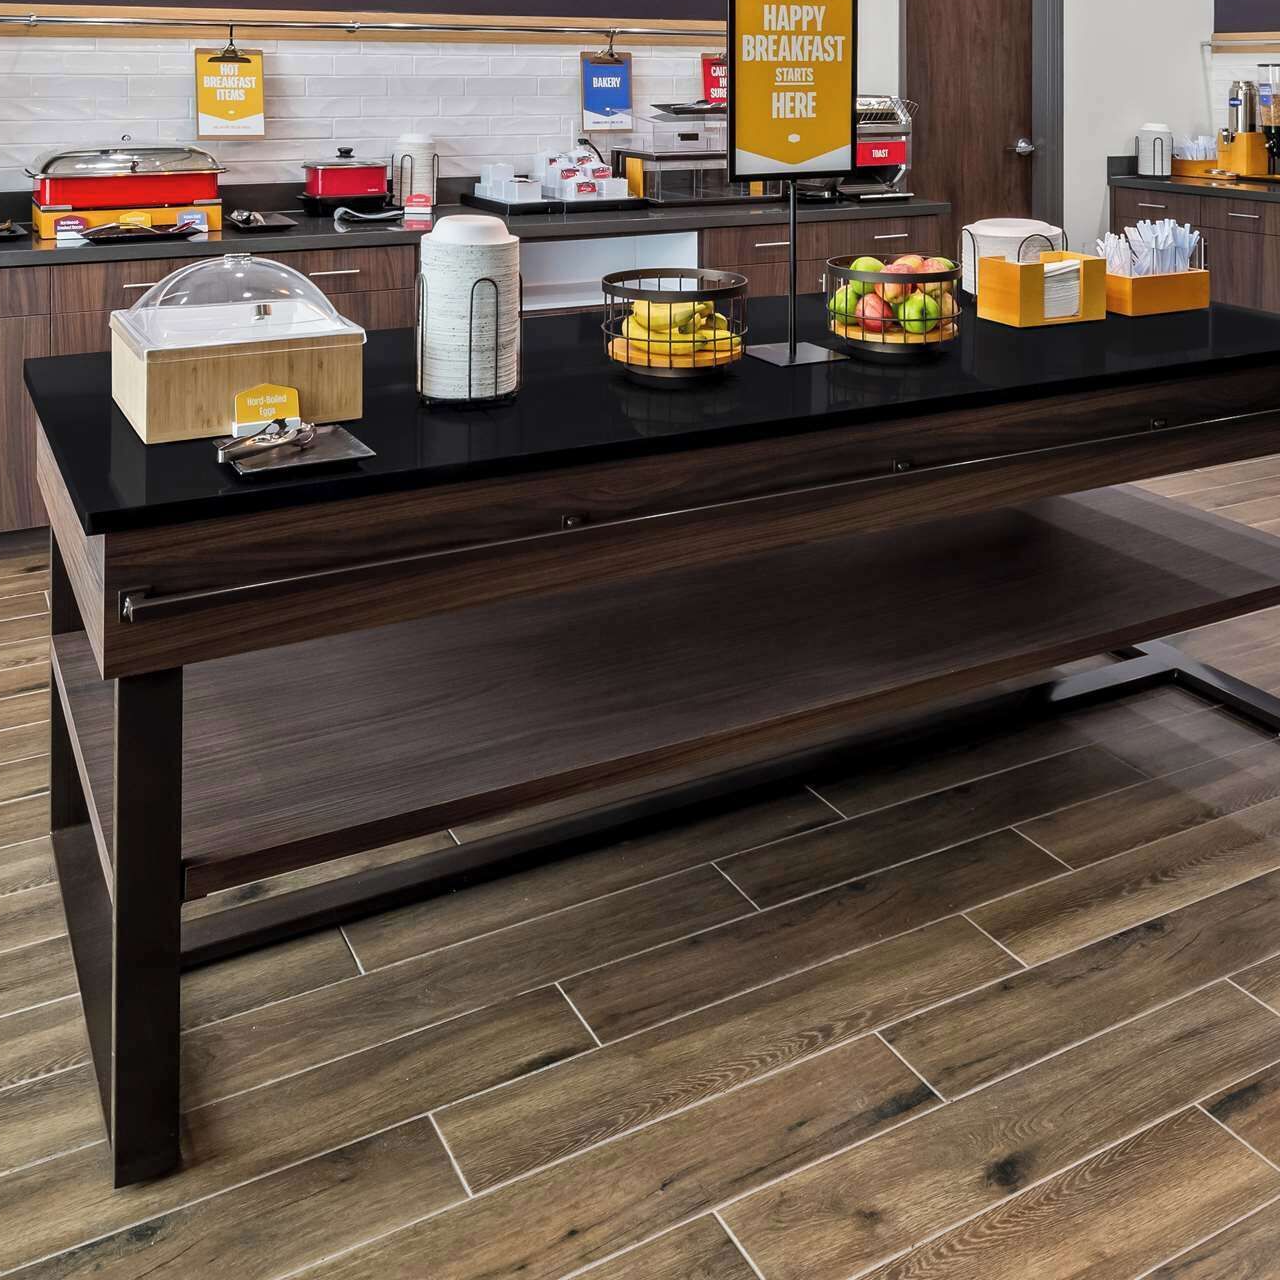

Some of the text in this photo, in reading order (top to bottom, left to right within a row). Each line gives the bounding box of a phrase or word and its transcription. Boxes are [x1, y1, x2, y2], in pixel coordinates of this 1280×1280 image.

[763, 4, 826, 32] HAPPY
[742, 34, 846, 62] BREAKFAST
[220, 64, 239, 76] HOT
[775, 67, 814, 82] STARTS
[203, 75, 257, 89] BREAKFAST
[592, 77, 621, 88] BAKERY
[216, 88, 246, 101] ITEMS
[771, 91, 817, 119] HERE
[872, 149, 889, 158] TOAST
[247, 394, 288, 407] Hard-Boiled
[259, 407, 276, 417] Eggs
